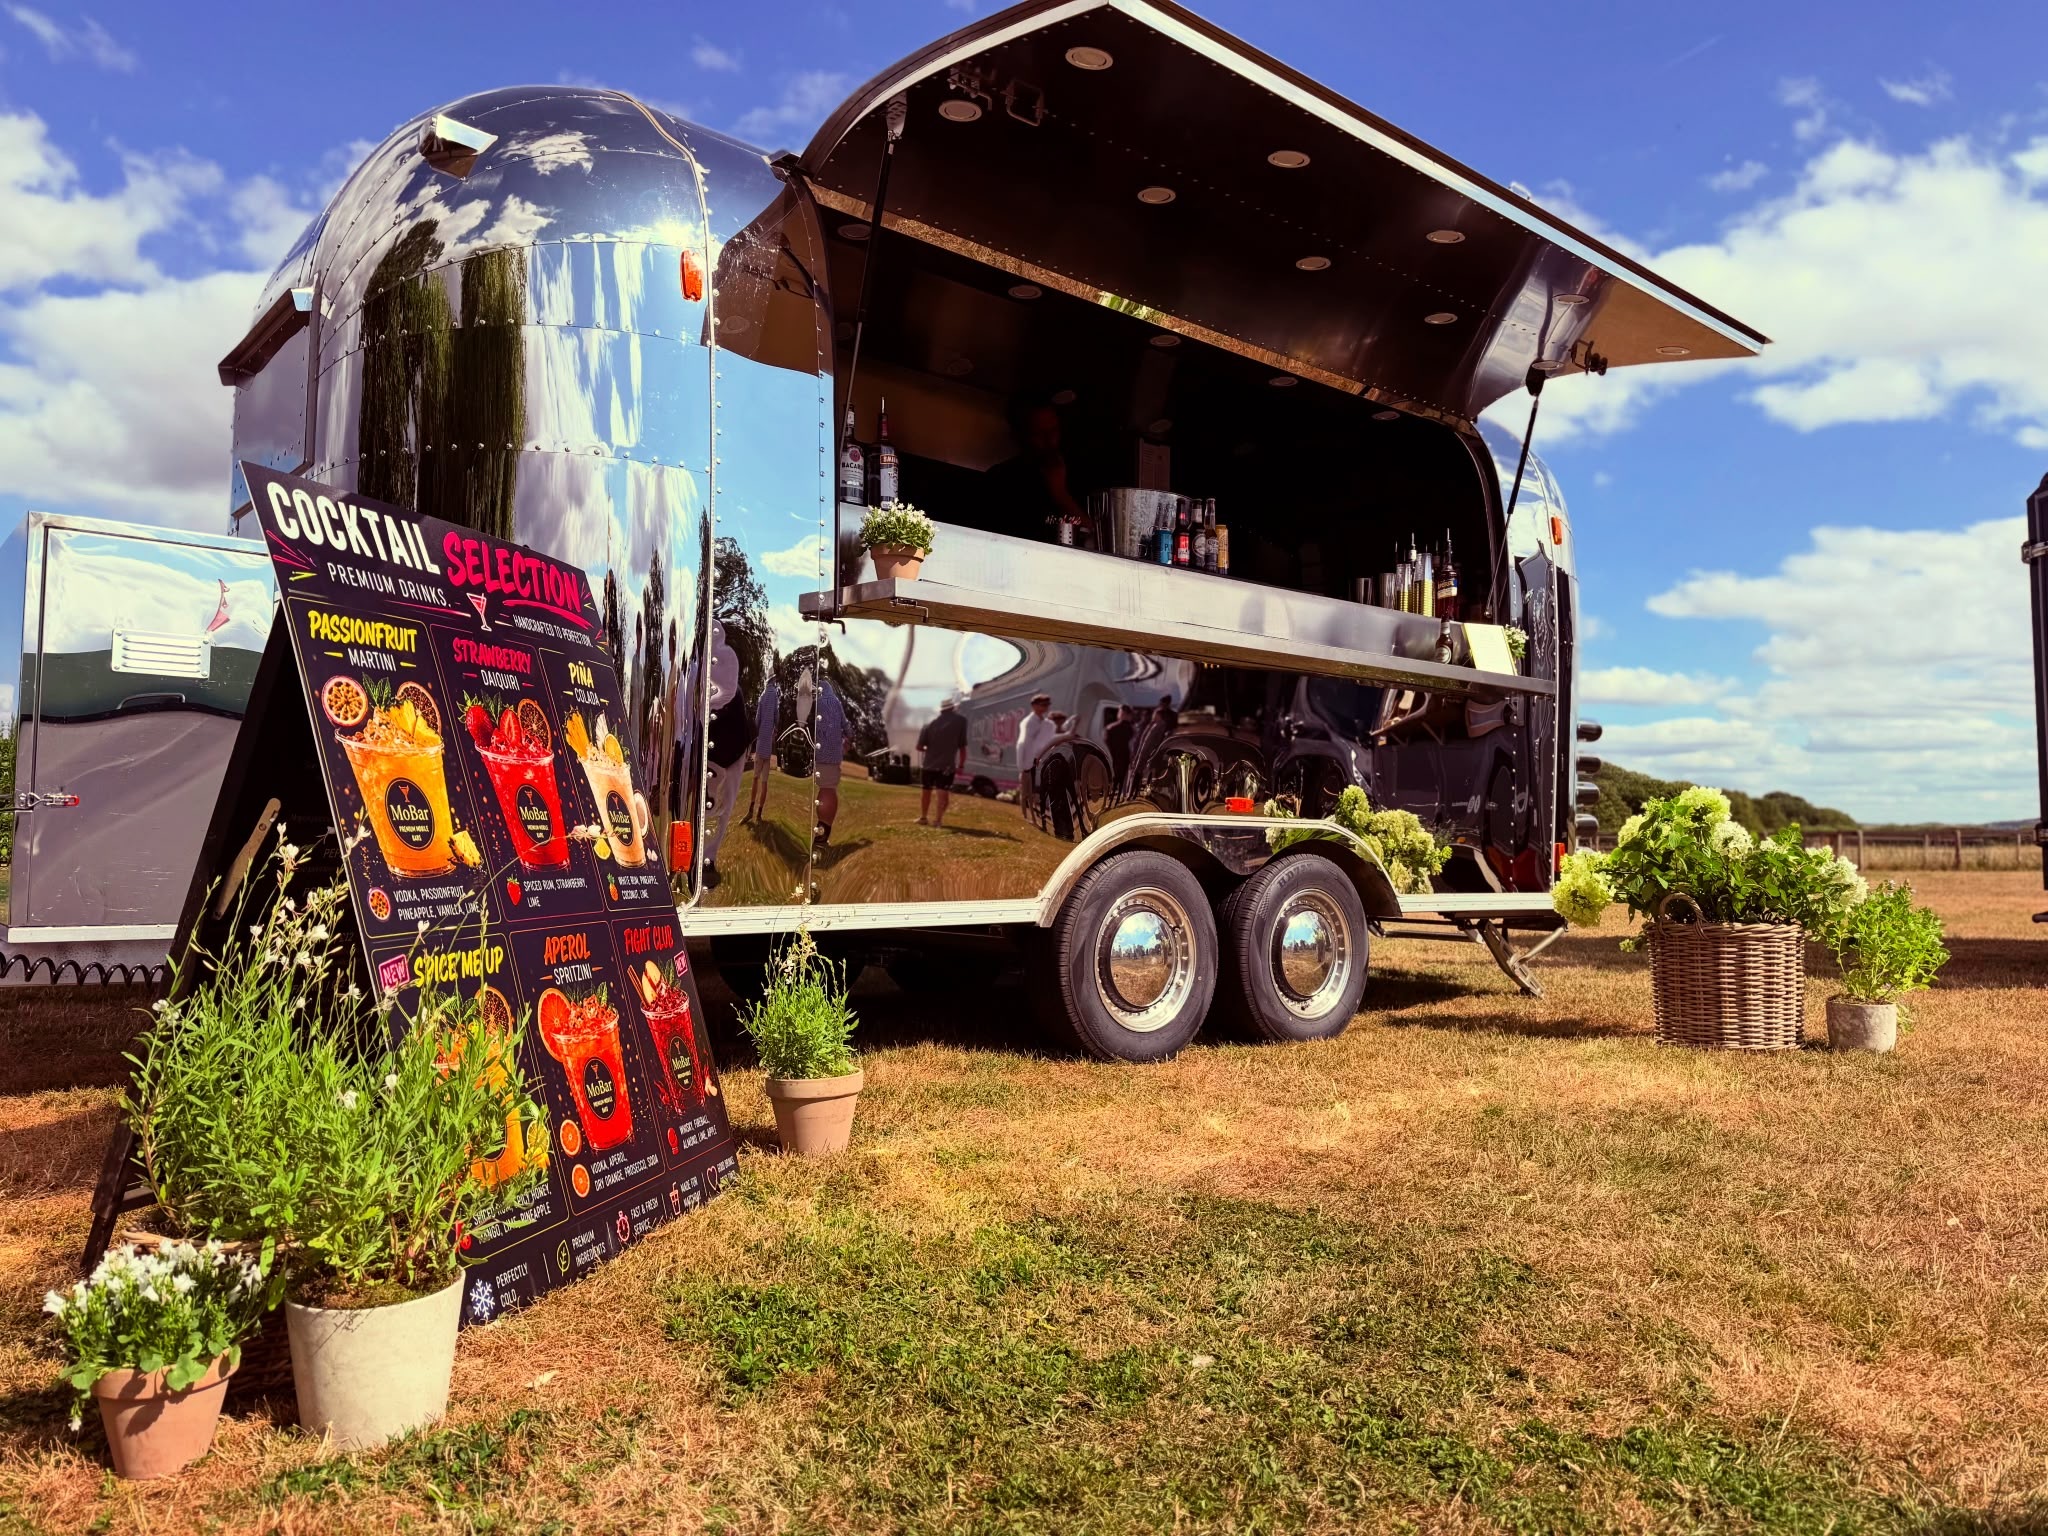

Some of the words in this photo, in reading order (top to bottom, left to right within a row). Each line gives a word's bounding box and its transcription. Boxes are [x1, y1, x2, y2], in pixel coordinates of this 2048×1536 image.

[267, 481, 441, 575] COCKTAIL
[442, 531, 582, 613] SELECTION
[327, 562, 395, 595] PREMIUM
[398, 579, 451, 607] DRINKS.
[308, 610, 417, 653] PASSIONFRUIT
[513, 614, 554, 637] HANDCRAFTED
[553, 625, 562, 639] TO
[348, 648, 397, 672] MARTINI
[453, 637, 532, 674] STRAWBERRY
[480, 669, 520, 691] DAIQUIRI
[574, 688, 601, 706] COLADA
[390, 804, 429, 820] MoBar
[519, 806, 548, 820] MoBar
[609, 810, 630, 823] MoBar
[393, 889, 420, 902] VODKA,
[523, 880, 542, 891] SPICED
[542, 880, 556, 891] RUM,
[398, 906, 437, 920] PINEAPPLE,
[436, 904, 465, 916] VANILLA,
[527, 896, 541, 907] LIME
[544, 932, 591, 965] APEROL
[623, 927, 650, 955] FIGHT
[652, 925, 674, 950] CLUB
[382, 960, 406, 985] NEW
[414, 952, 458, 987] SPICE
[461, 949, 481, 979] ME
[485, 946, 503, 974] UP
[553, 963, 592, 985] SPRITZINI
[672, 1056, 690, 1070] MoBar
[586, 1079, 613, 1098] MoBar
[591, 1160, 610, 1174] VODKA,
[647, 1153, 659, 1167] SODA
[516, 1190, 531, 1205] PICY
[531, 1182, 552, 1201] HONEY,
[520, 1201, 552, 1221] PINEAPPLE
[630, 1205, 642, 1219] FAST
[641, 1204, 647, 1214] &
[645, 1197, 659, 1212] FRESH
[633, 1217, 651, 1236] SERVICE
[571, 1229, 596, 1250] PREMIUM
[575, 1241, 607, 1267] INGREDIENTS
[495, 1261, 529, 1289] PERFECTLY
[500, 1288, 517, 1308] COLD
